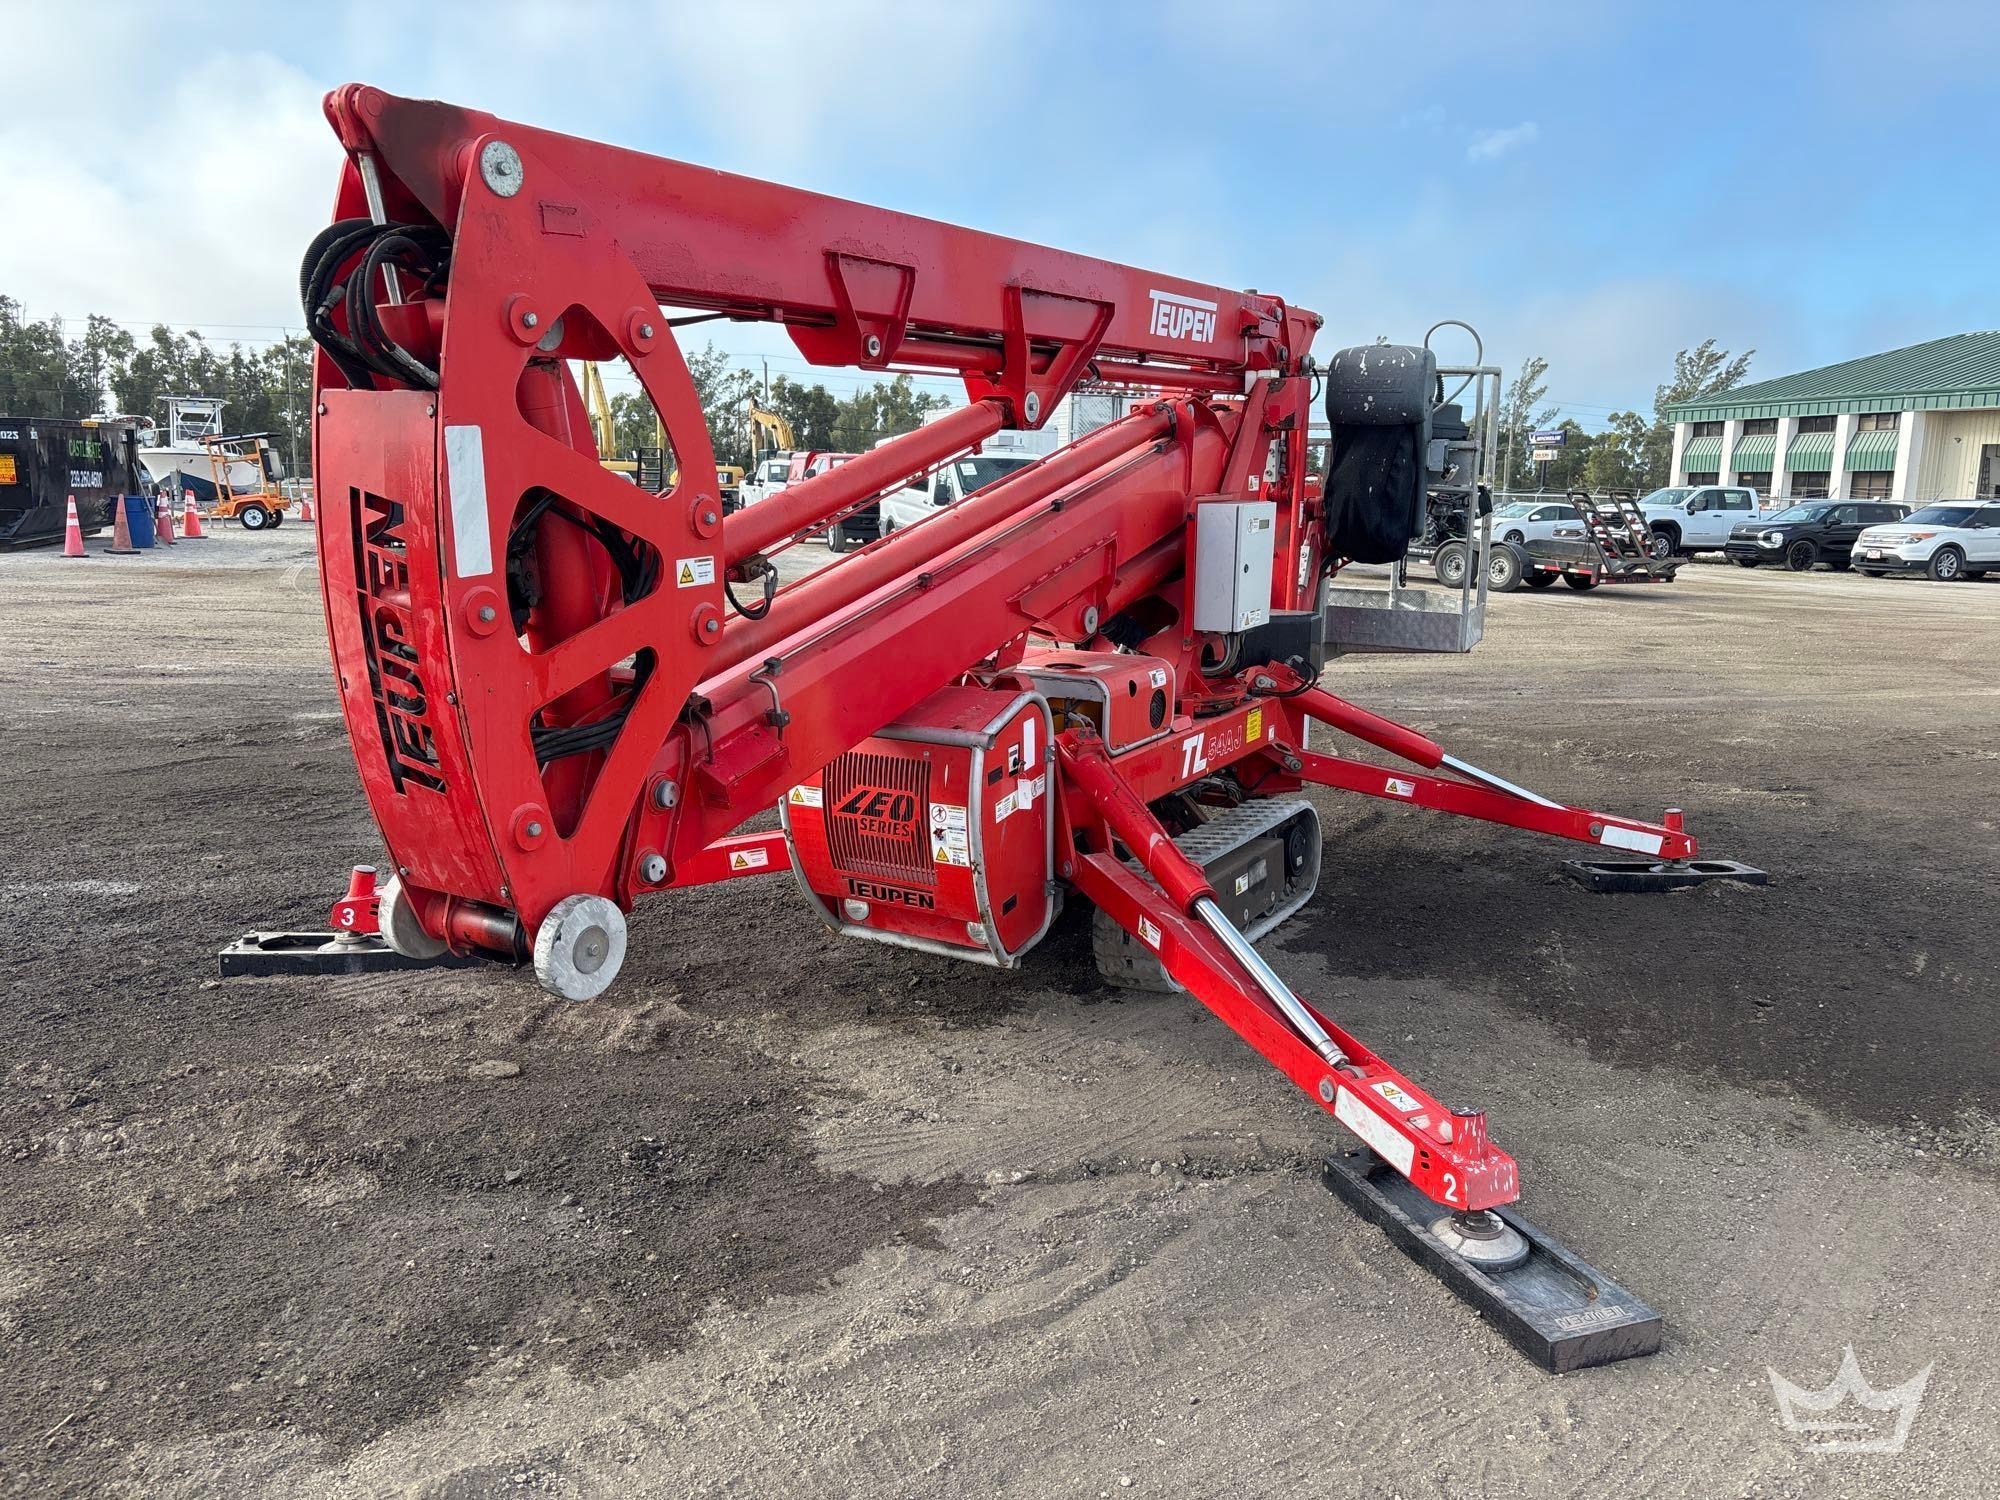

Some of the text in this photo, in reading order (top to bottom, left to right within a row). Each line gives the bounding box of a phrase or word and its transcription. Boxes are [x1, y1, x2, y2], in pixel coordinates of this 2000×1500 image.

[1149, 288, 1218, 344] TEUPEN
[717, 472, 729, 484] AT
[349, 485, 448, 797] TEUPEN
[1182, 732, 1207, 779] TL
[838, 790, 914, 822] LEO
[860, 817, 911, 837] SERIES
[1684, 839, 1691, 853] 1
[841, 875, 935, 910] TEUPEN
[340, 907, 355, 927] 3
[1442, 1172, 1458, 1203] 2
